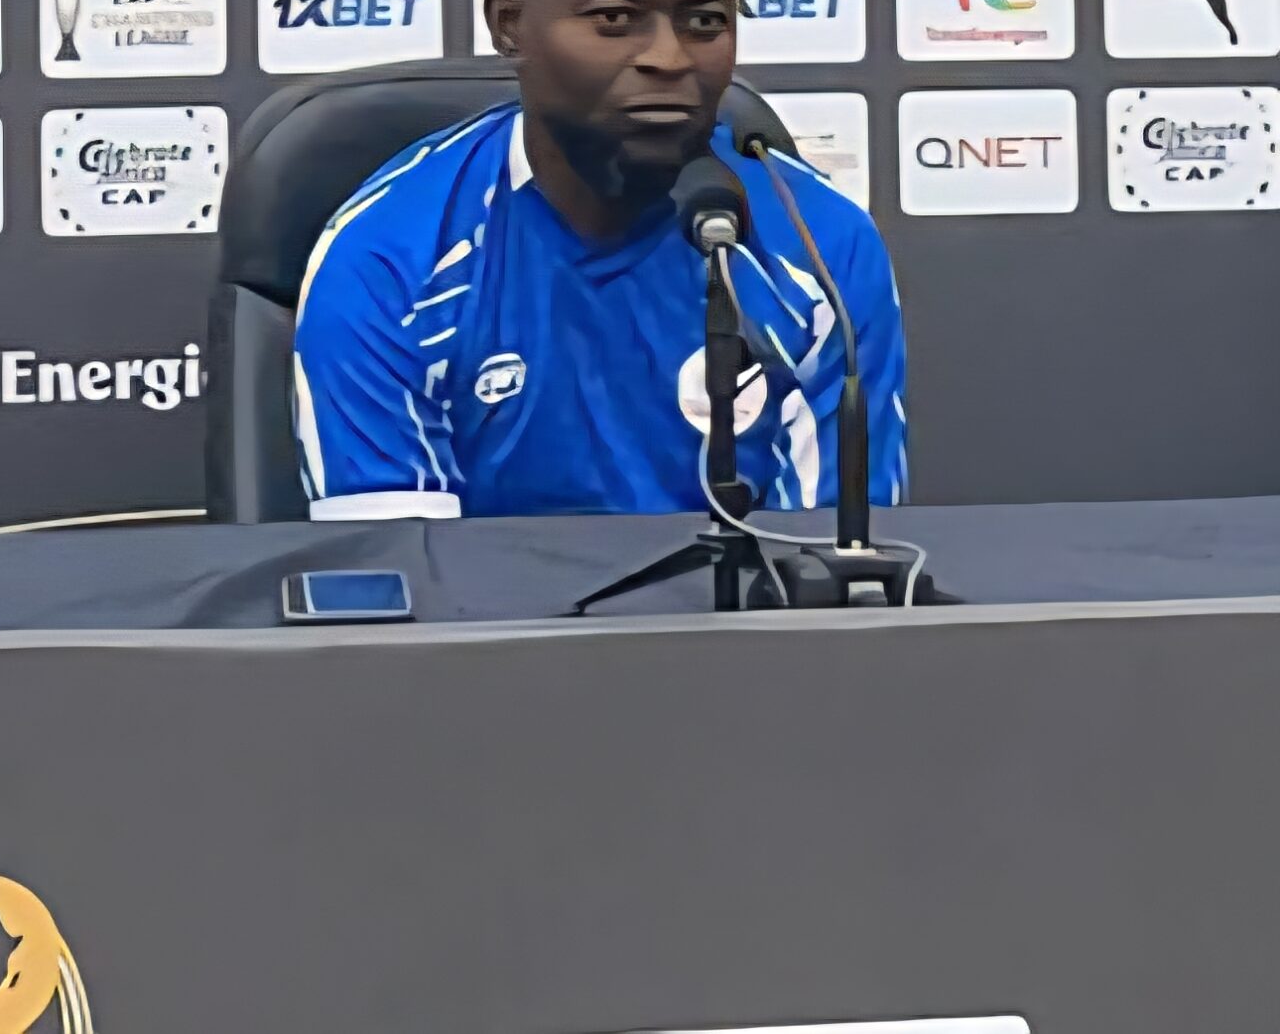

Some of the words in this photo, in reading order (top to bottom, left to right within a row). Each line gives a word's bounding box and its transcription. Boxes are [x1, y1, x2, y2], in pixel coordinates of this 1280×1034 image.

[916, 137, 1062, 168] QNET
[1165, 166, 1225, 182] CAF
[101, 188, 166, 205] CAF
